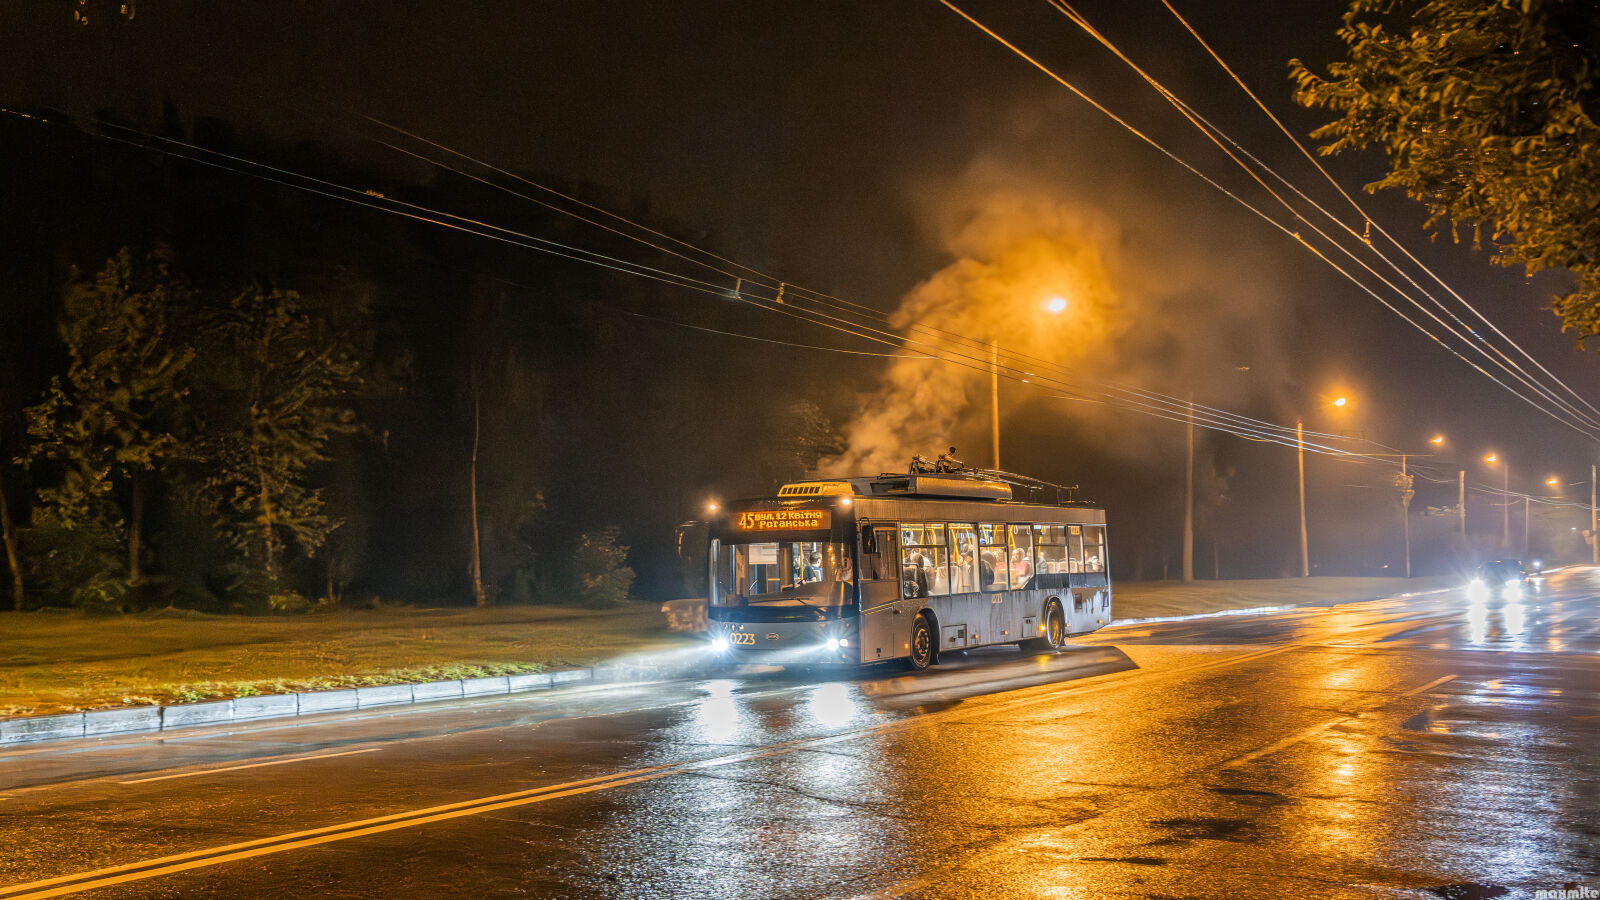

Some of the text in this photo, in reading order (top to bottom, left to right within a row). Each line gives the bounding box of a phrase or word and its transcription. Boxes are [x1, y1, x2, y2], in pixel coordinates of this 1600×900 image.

[739, 513, 755, 529] 45
[775, 512, 787, 520] 12
[788, 511, 823, 519] Квітня
[759, 519, 818, 529] Роганська
[729, 632, 756, 645] 0223
